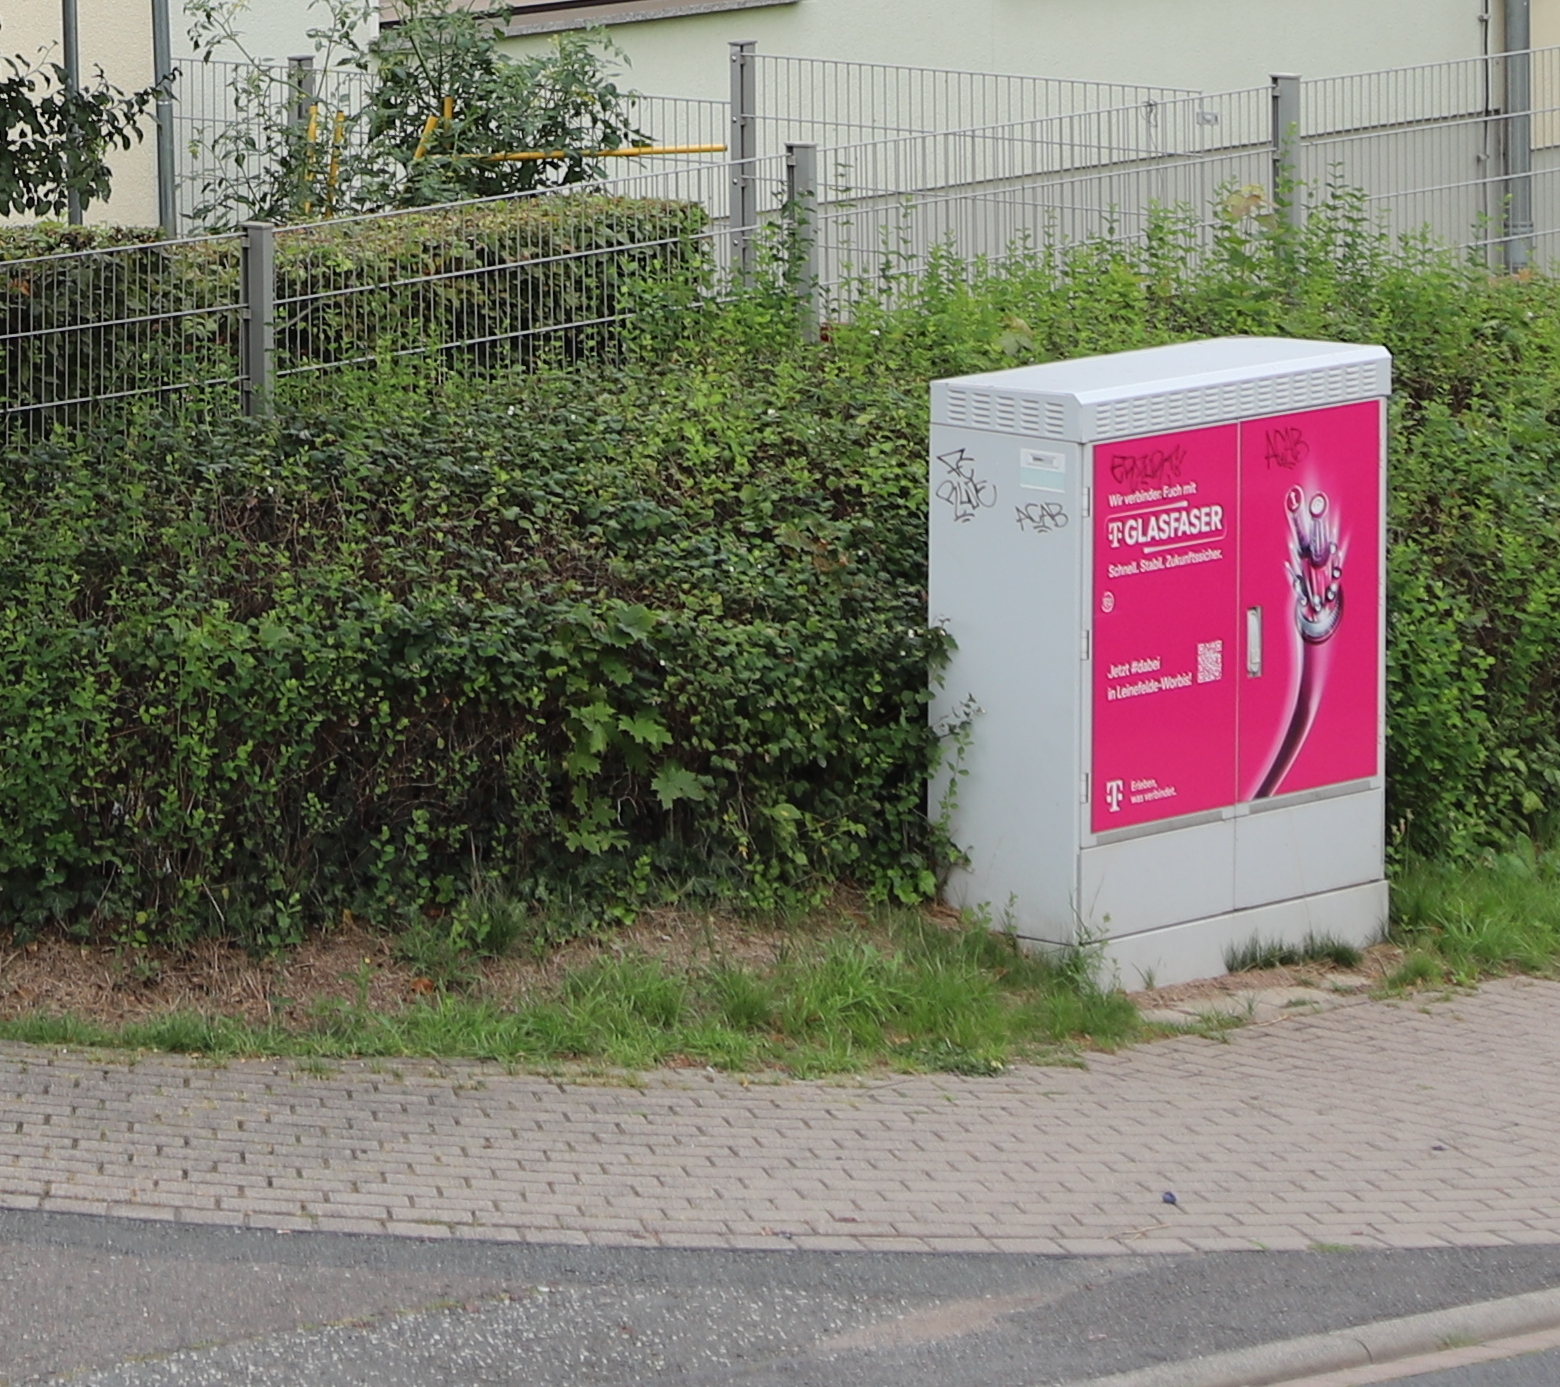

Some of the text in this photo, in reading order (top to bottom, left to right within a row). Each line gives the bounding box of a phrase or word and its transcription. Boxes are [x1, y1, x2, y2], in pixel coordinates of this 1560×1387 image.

[1109, 494, 1123, 507] Wir
[1183, 482, 1196, 494] mit
[1015, 501, 1069, 532] ACAB
[1124, 505, 1223, 546] GLASFASER
[1108, 548, 1223, 578] Schnell. Stabil. Zukunftssicher.
[1107, 656, 1161, 679] Jetzt #dabei
[1107, 672, 1193, 700] in Leinefelde-Worbis!
[1131, 795, 1143, 804] was
